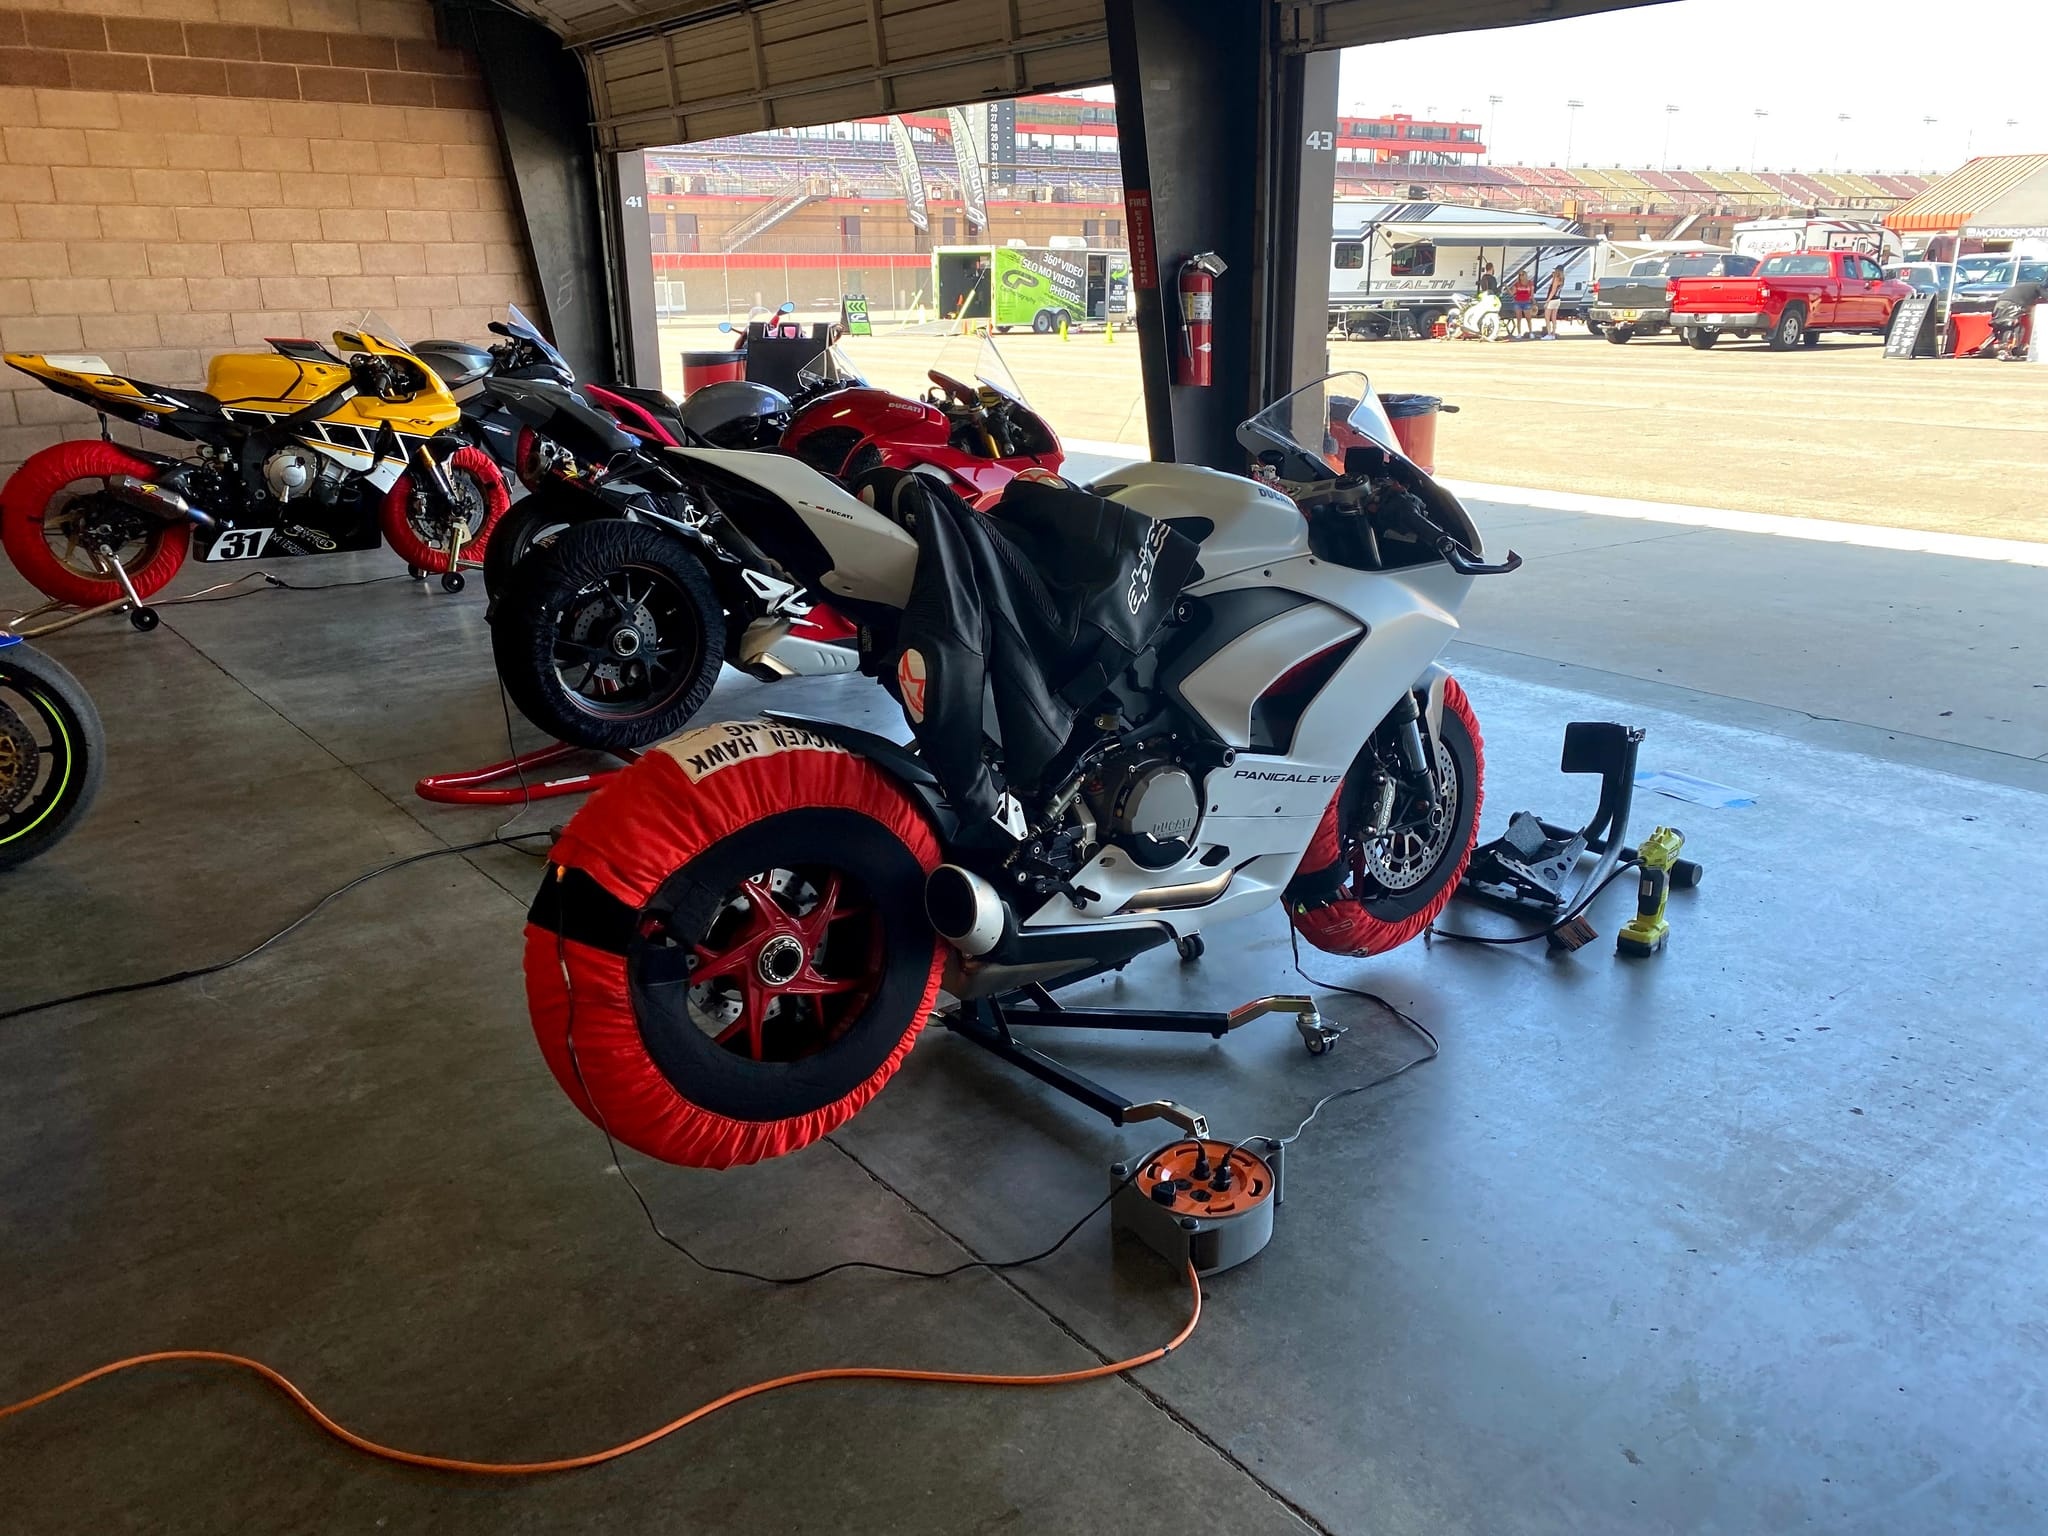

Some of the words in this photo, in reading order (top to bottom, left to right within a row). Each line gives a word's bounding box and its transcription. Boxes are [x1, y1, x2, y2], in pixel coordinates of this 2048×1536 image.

[990, 113, 998, 122] 27
[1306, 130, 1333, 150] 43
[991, 143, 999, 151] 30
[991, 152, 998, 161] 31
[625, 195, 643, 208] 41
[1129, 198, 1148, 208] FIRE
[1976, 227, 2048, 238] MOTORSPORT
[1022, 258, 1038, 273] SLO
[1038, 266, 1052, 279] MO
[1052, 271, 1076, 289] VIDEO
[1061, 260, 1084, 278] VIDEO
[1357, 280, 1456, 290] STEALTH
[1049, 284, 1081, 304] PHOTOS
[888, 402, 922, 413] DUCATI
[825, 508, 853, 520] DUCATI
[220, 531, 262, 559] 31
[686, 736, 758, 774] HAWK
[1233, 770, 1321, 784] PANIGALE
[1322, 774, 1341, 784] V2
[1381, 791, 1393, 825] brembo
[1153, 817, 1191, 834] DUCATI
